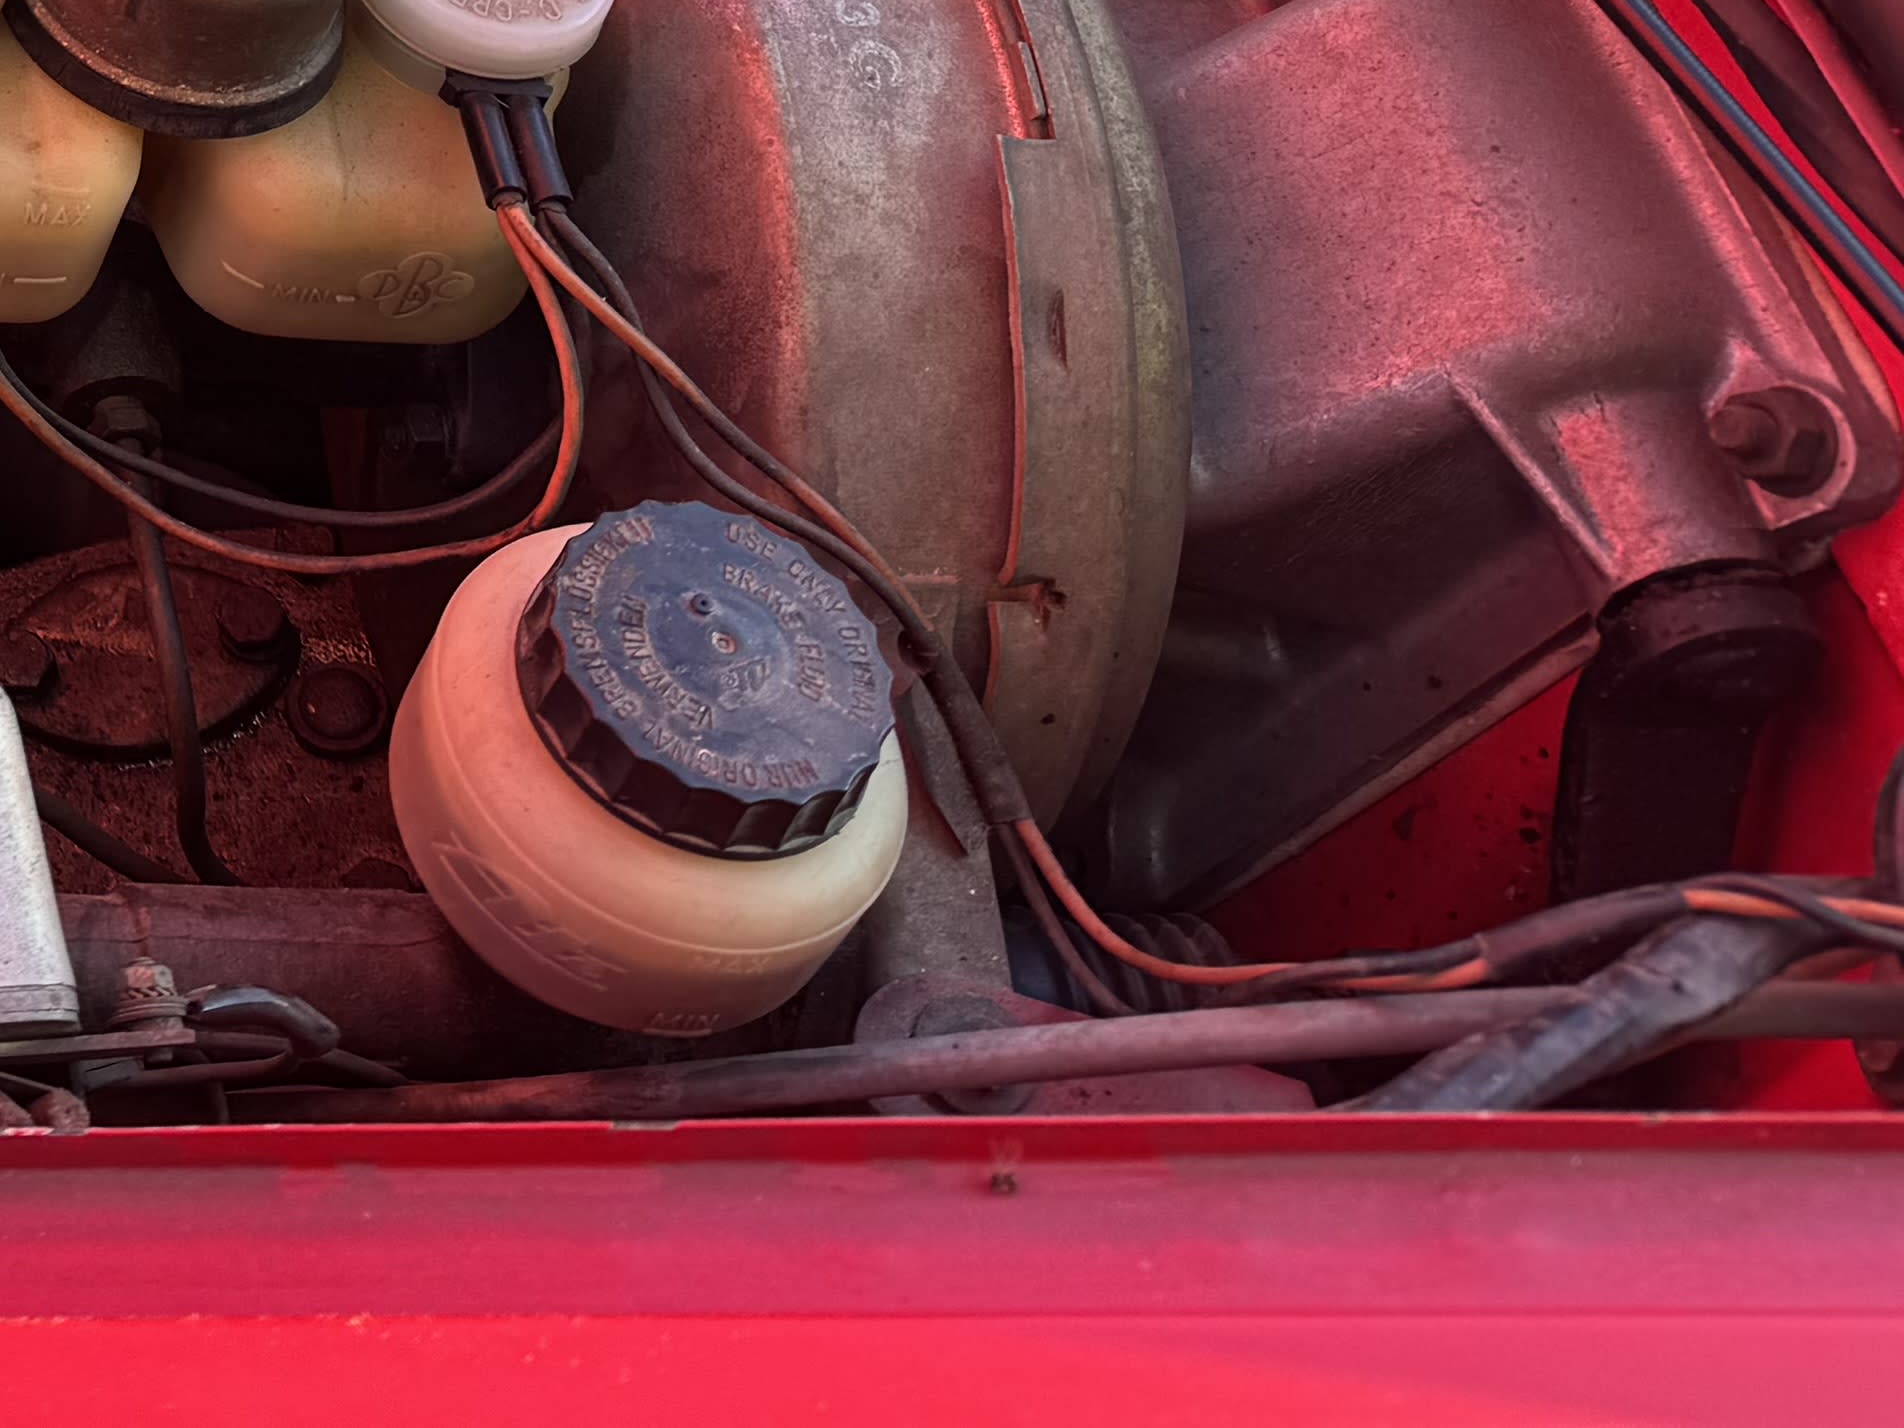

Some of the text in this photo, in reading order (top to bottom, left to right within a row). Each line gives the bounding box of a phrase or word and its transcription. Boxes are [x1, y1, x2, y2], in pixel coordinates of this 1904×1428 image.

[24, 201, 92, 226] MAX
[725, 521, 779, 562] USE
[723, 562, 808, 631] BRAKE
